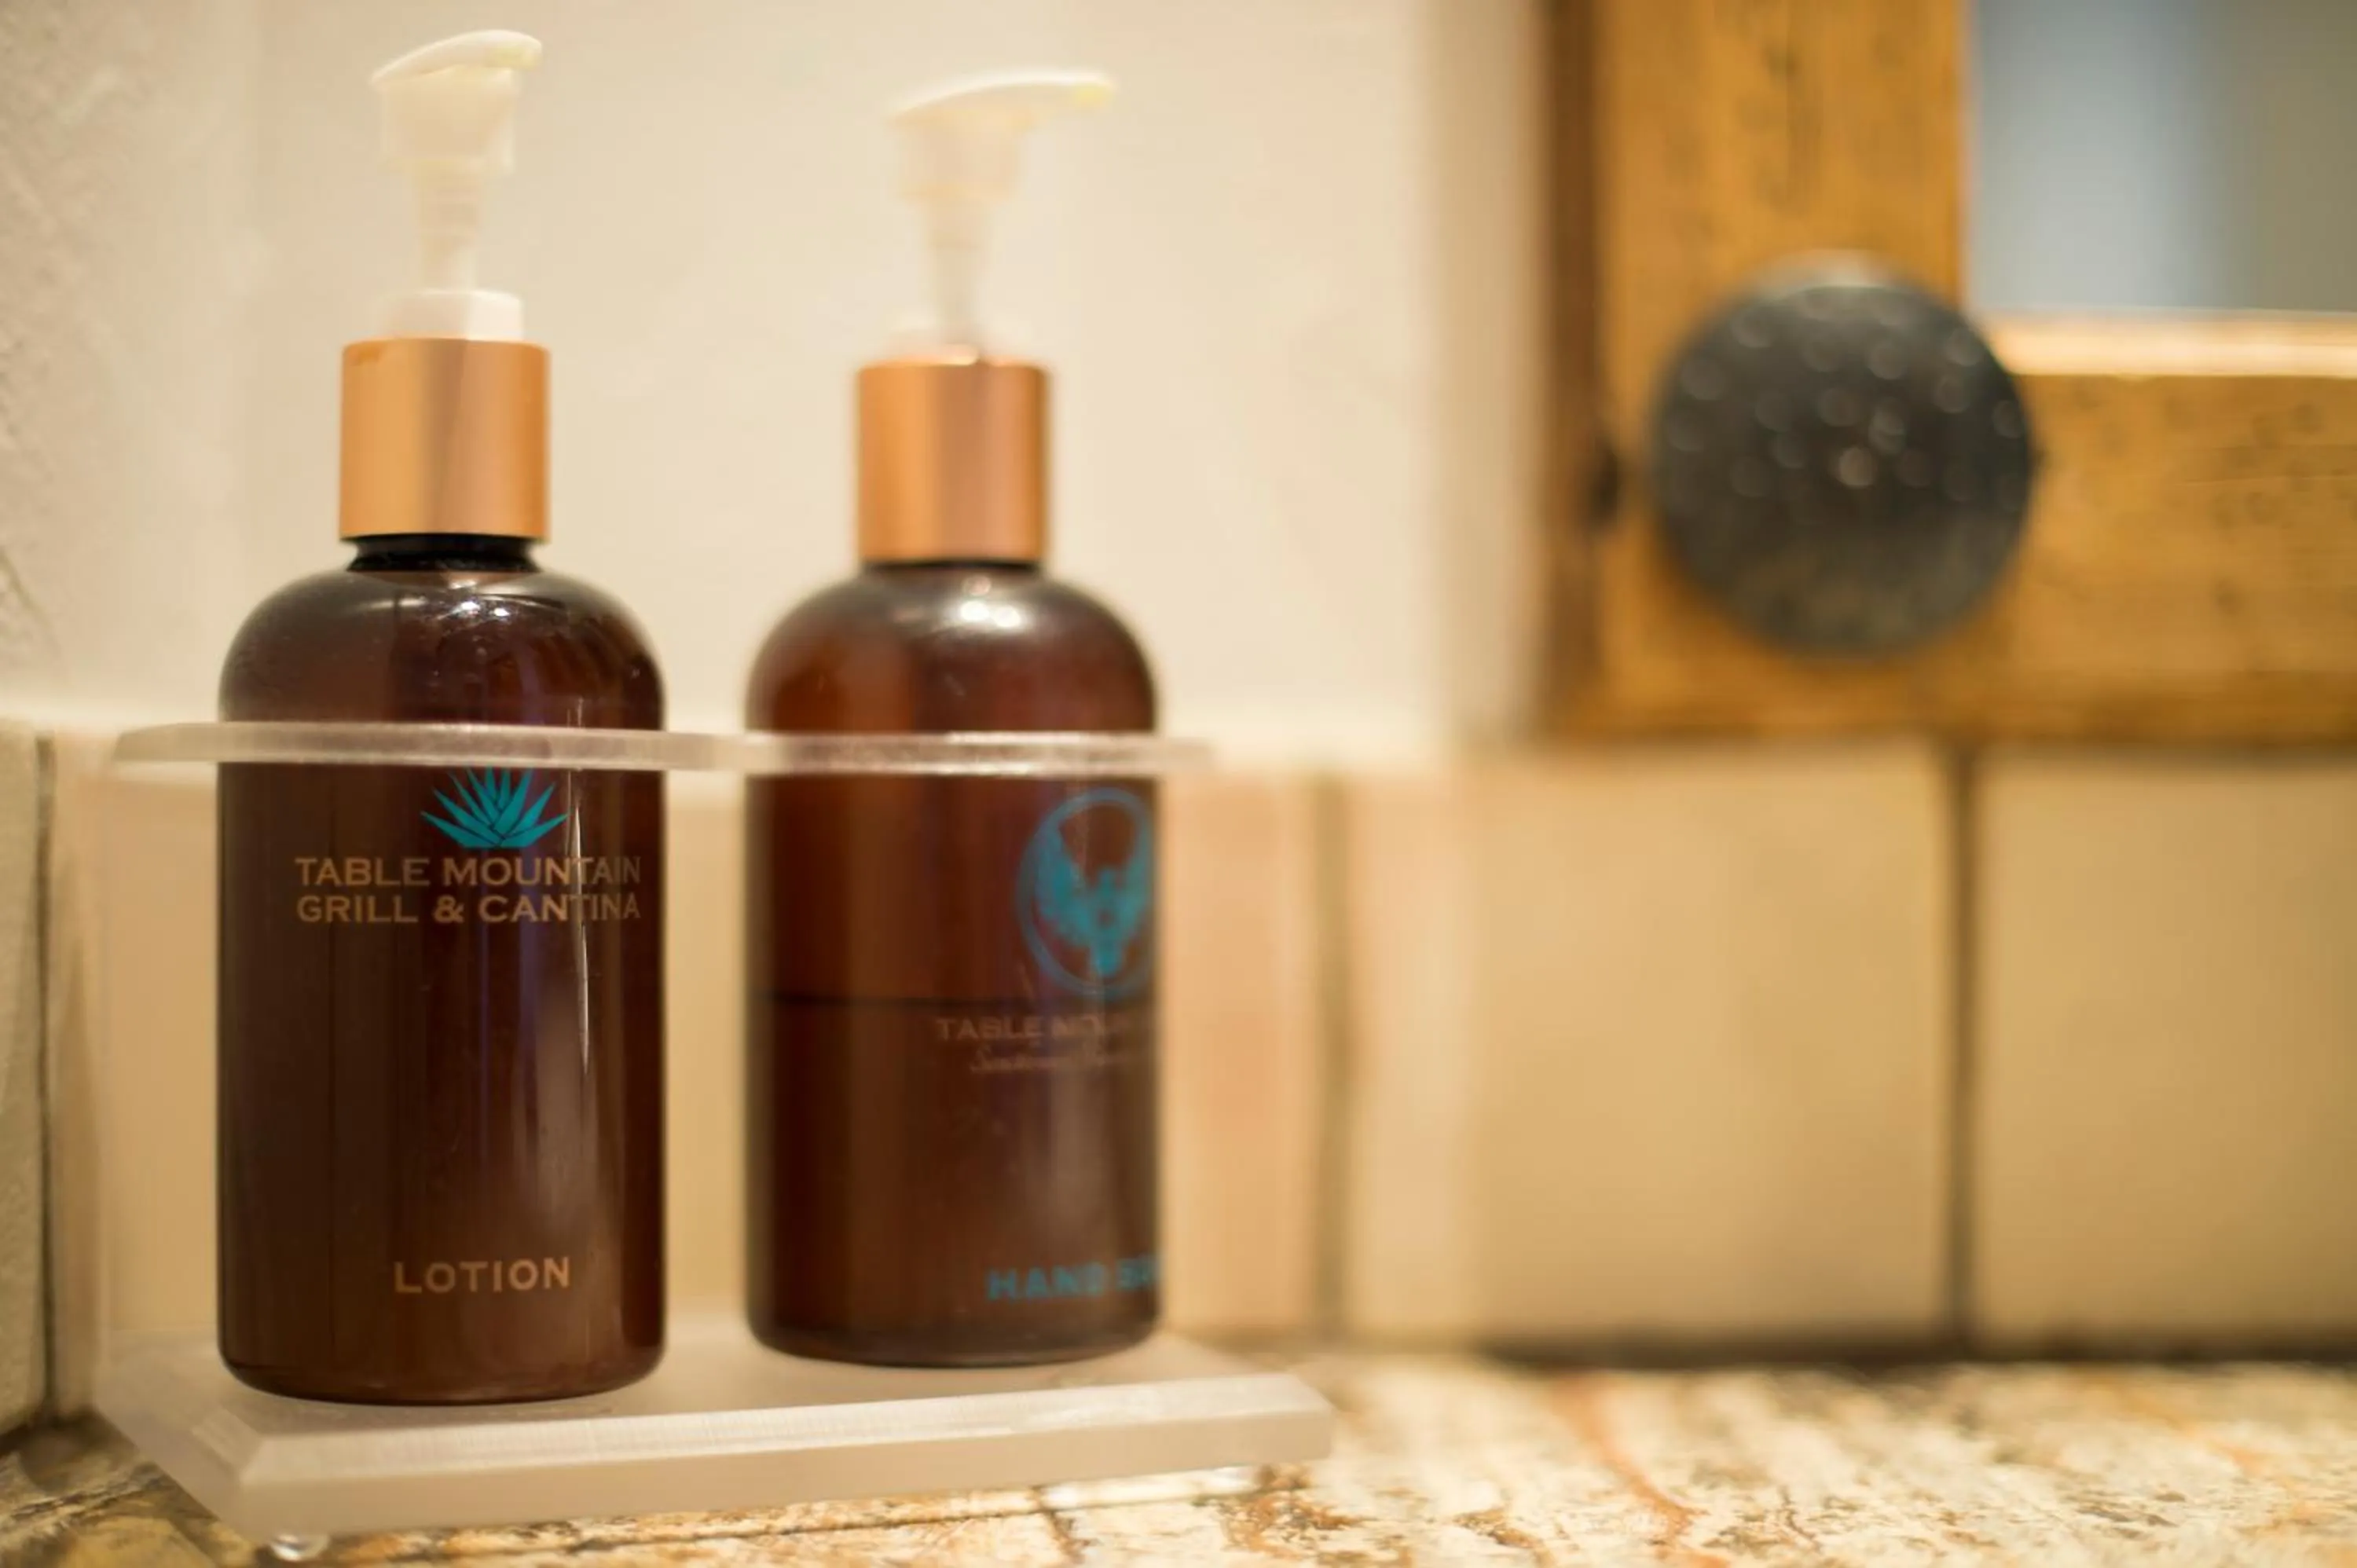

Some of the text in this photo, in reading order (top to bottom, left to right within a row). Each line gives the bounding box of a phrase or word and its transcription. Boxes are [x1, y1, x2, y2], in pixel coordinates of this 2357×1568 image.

[295, 856, 642, 886] TABLE MOUNTAIN
[295, 892, 642, 923] GRILL & CANTINA
[935, 1017, 1043, 1041] TABLE
[393, 1257, 571, 1294] LOTION
[985, 1261, 1109, 1302] HAND
